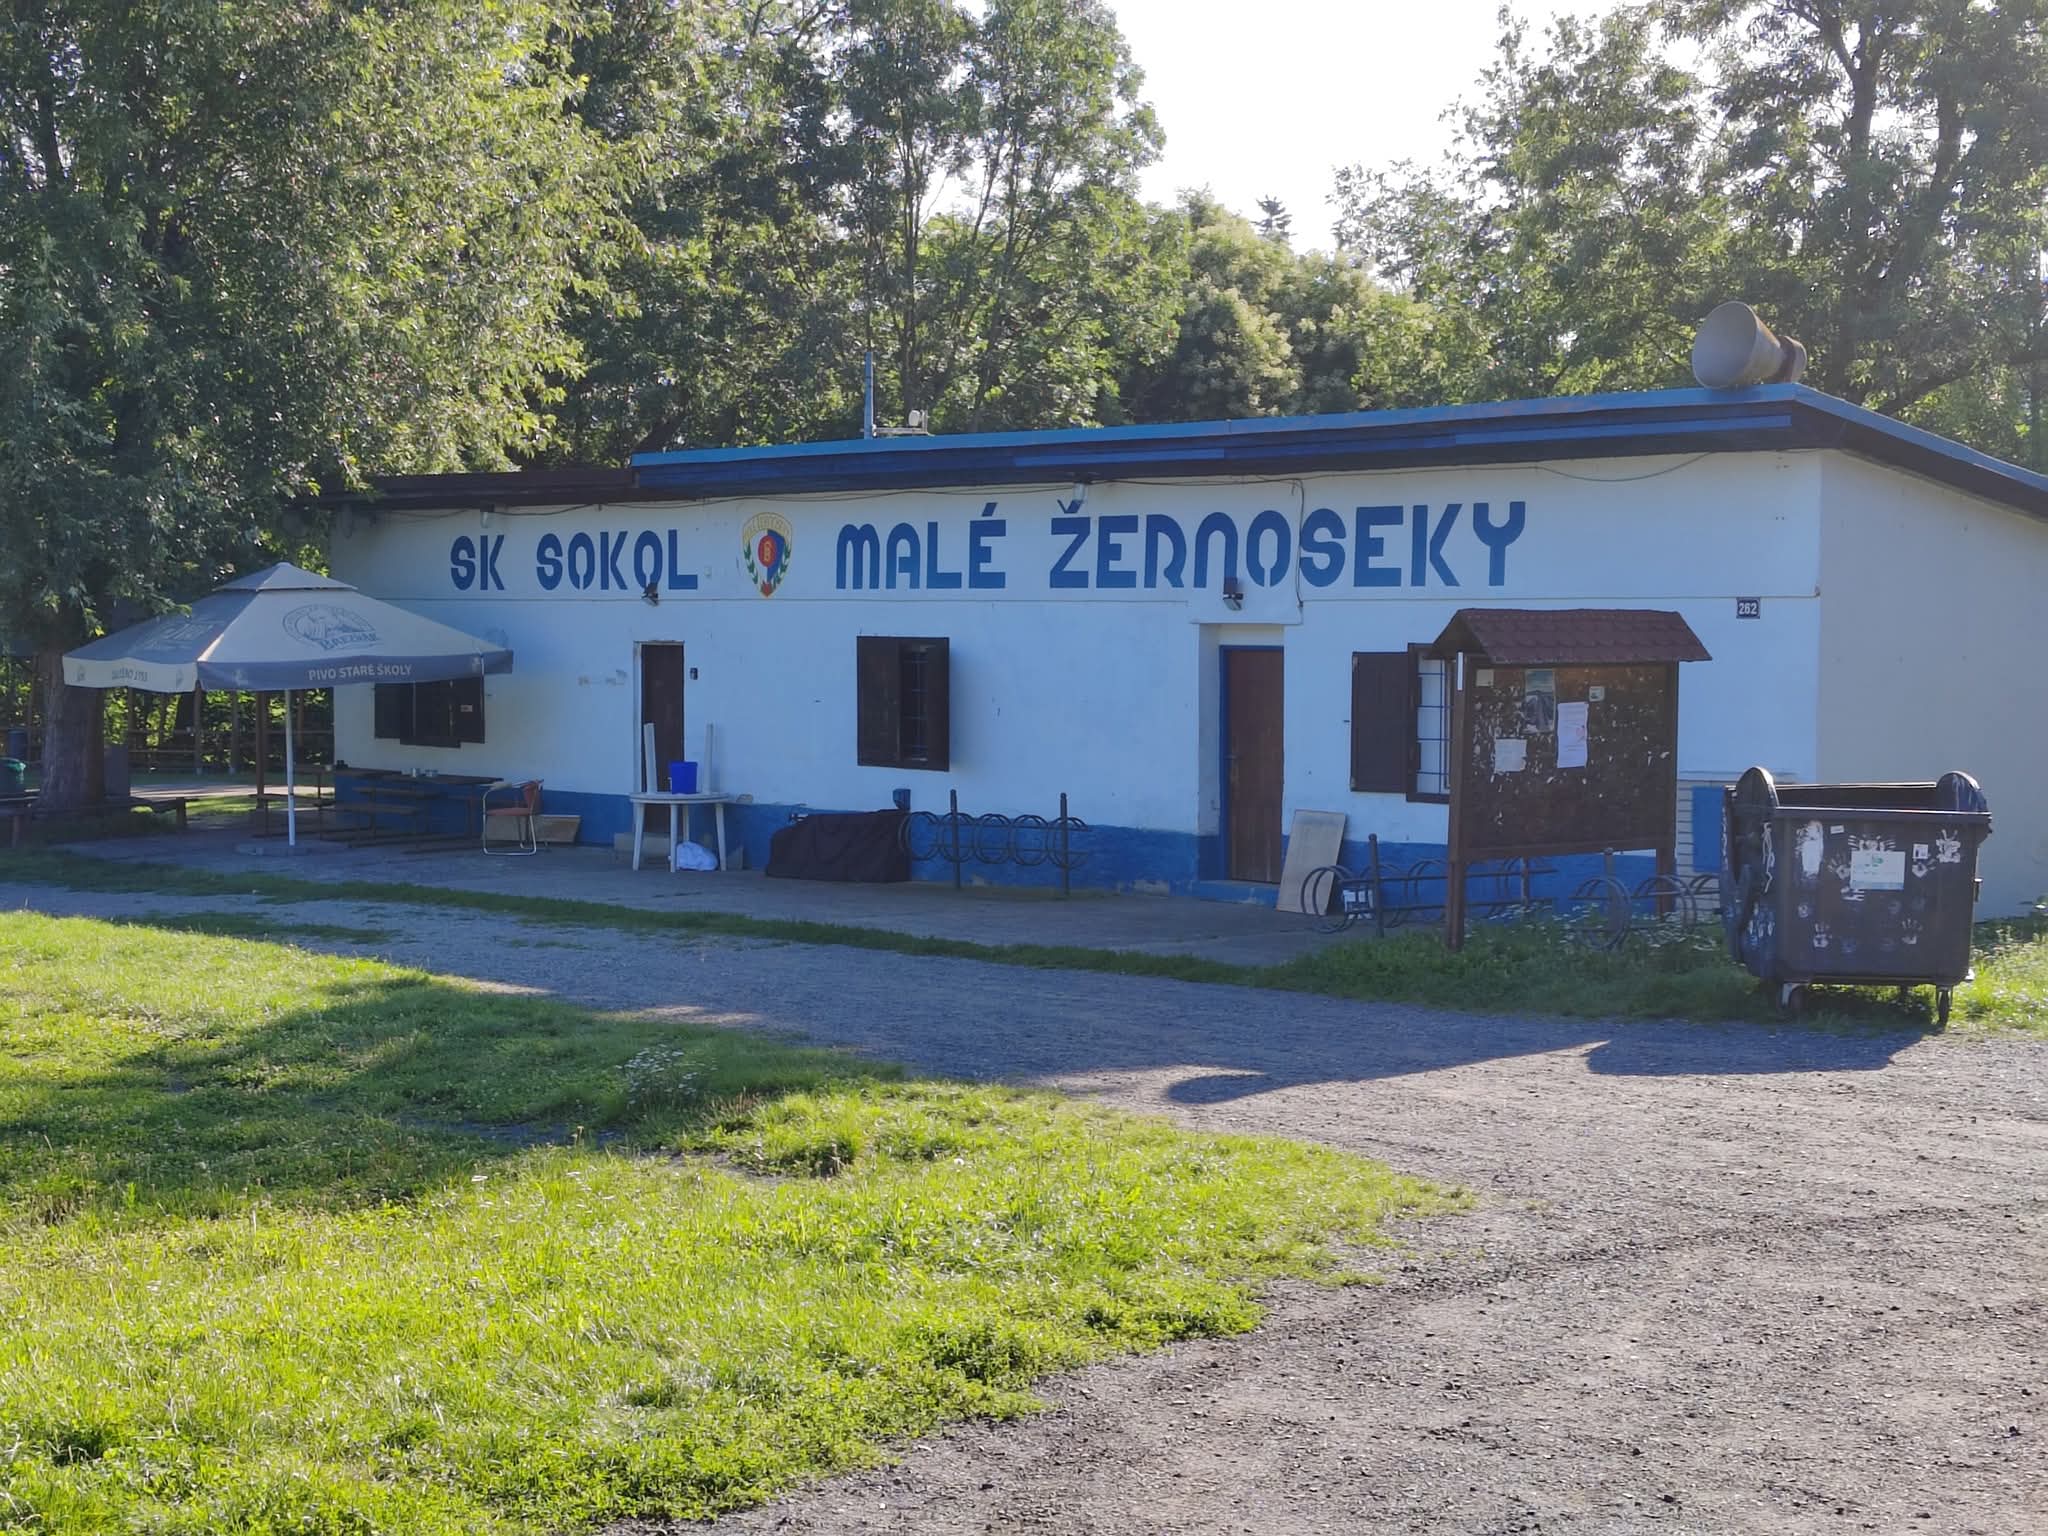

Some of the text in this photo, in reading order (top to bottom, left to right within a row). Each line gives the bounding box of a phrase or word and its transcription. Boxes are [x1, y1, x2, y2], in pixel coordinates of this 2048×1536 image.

[450, 535, 505, 590] SK
[536, 529, 698, 590] SOKOL
[837, 502, 1007, 589] MALÉ
[1050, 500, 1527, 588] ŽERNOSEKY
[1738, 602, 1758, 615] 262
[308, 663, 413, 680] PIVO STARÉ ŠKOLY
